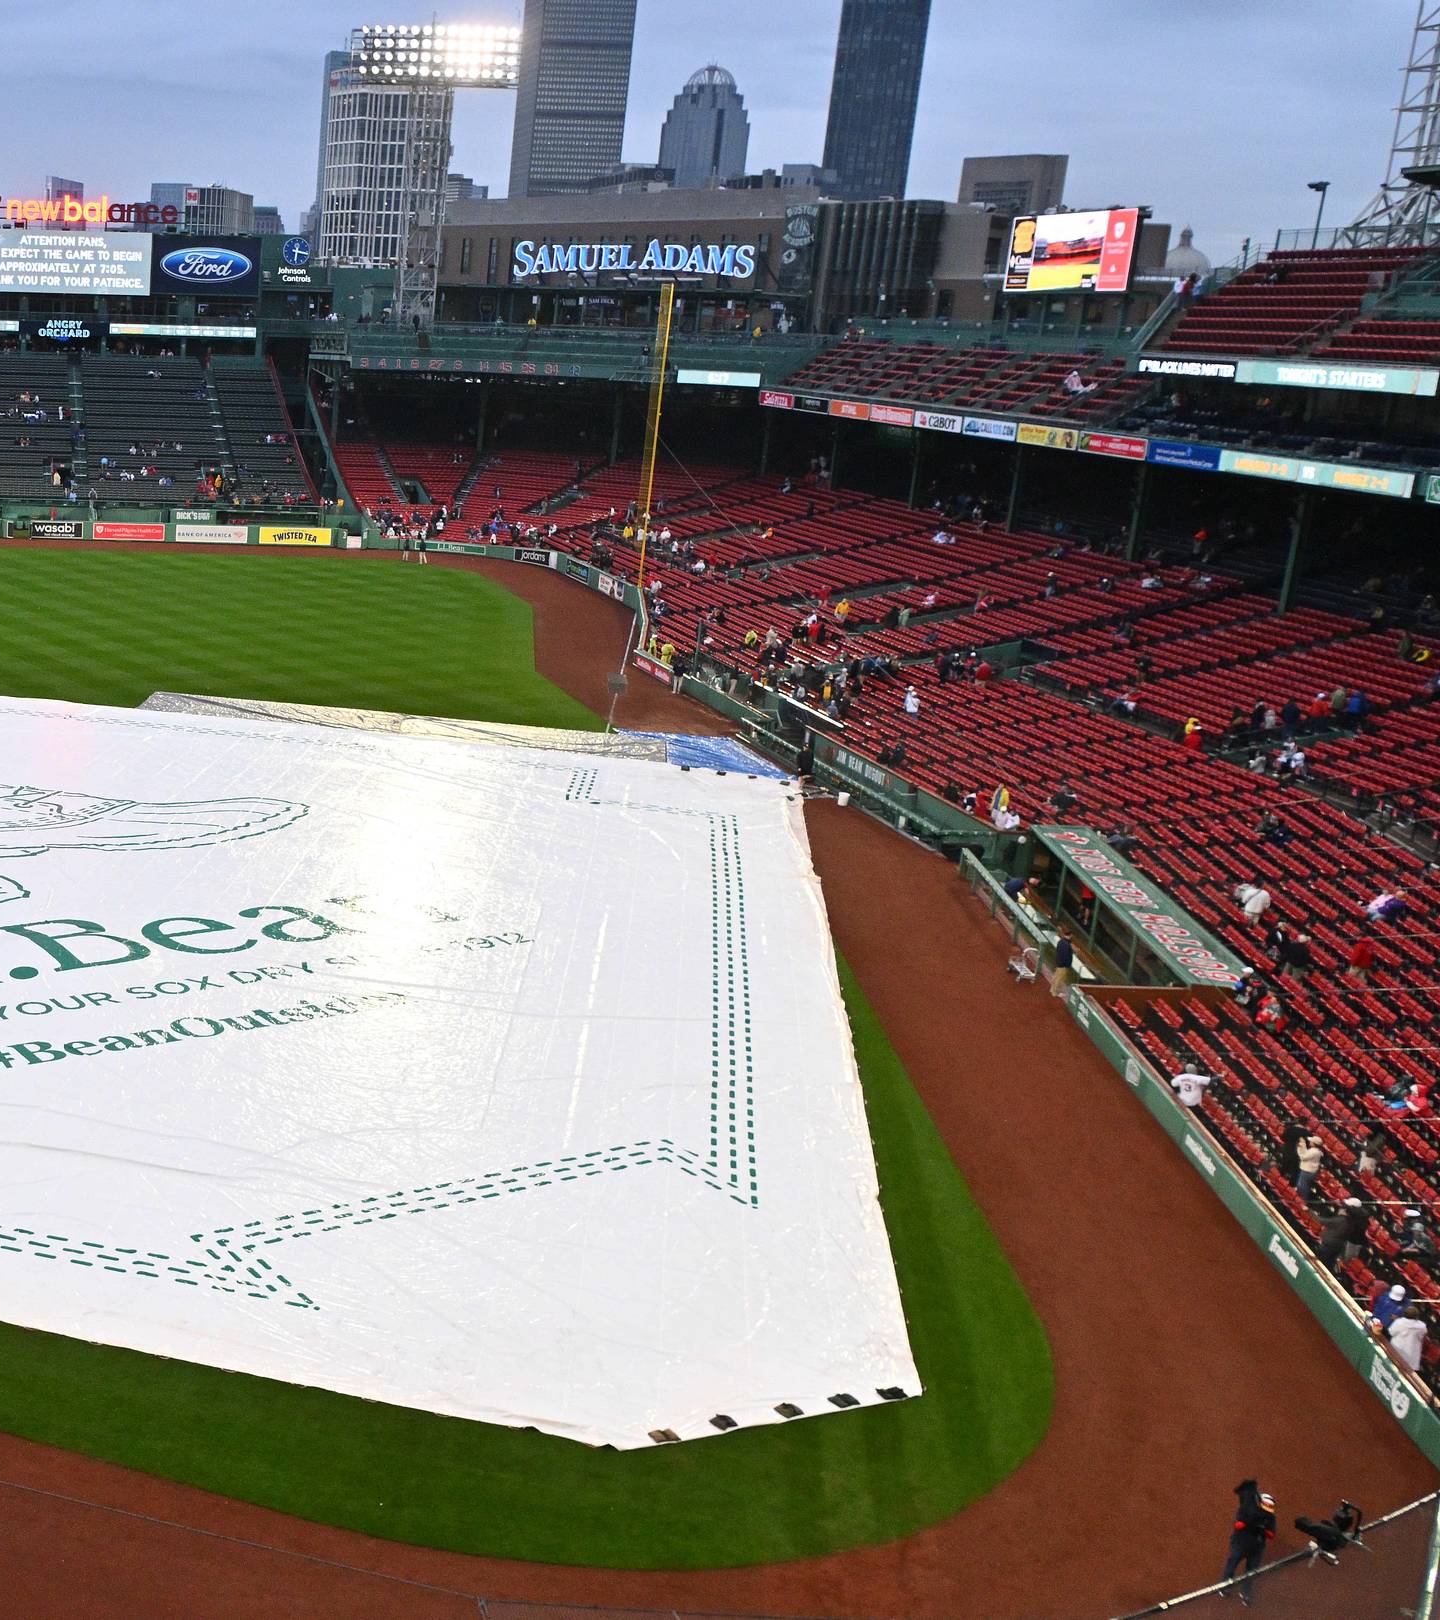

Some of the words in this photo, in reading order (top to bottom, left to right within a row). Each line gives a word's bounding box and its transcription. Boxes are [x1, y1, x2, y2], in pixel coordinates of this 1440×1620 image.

[19, 235, 76, 247] ATTENTION
[78, 236, 107, 249] FANS,
[1, 248, 40, 259] EXPECT
[42, 249, 63, 260] THE
[65, 250, 94, 261] GAME
[98, 251, 110, 261] TO
[113, 251, 143, 262] BEGIN
[513, 240, 638, 278] SAMUEL
[639, 238, 756, 279] ADAMS
[82, 264, 97, 274] AT
[100, 264, 127, 275] 7:05.
[178, 251, 232, 278] Ford
[277, 266, 307, 275] Johnson
[17, 275, 38, 286] YOU
[40, 275, 61, 286] FOR
[64, 276, 91, 287] YOUR
[93, 277, 144, 289] PATIENCE.
[282, 275, 312, 283] Controls
[46, 320, 82, 329] ANGRY
[38, 329, 90, 338] ORCHARD
[1328, 368, 1386, 388] STARTERS
[176, 511, 198, 520] DICK'S
[34, 523, 75, 533] wasabi
[272, 532, 303, 543] TWISTED
[304, 532, 318, 544] TEA
[836, 749, 847, 764] JIM
[848, 755, 863, 774] BEAM
[864, 764, 886, 786] DUGOUT
[1060, 844, 1124, 876] SOX
[1092, 875, 1160, 909] RED
[1128, 910, 1241, 983] BOSTON
[123, 973, 224, 1000] SOX
[227, 960, 314, 985] DRY
